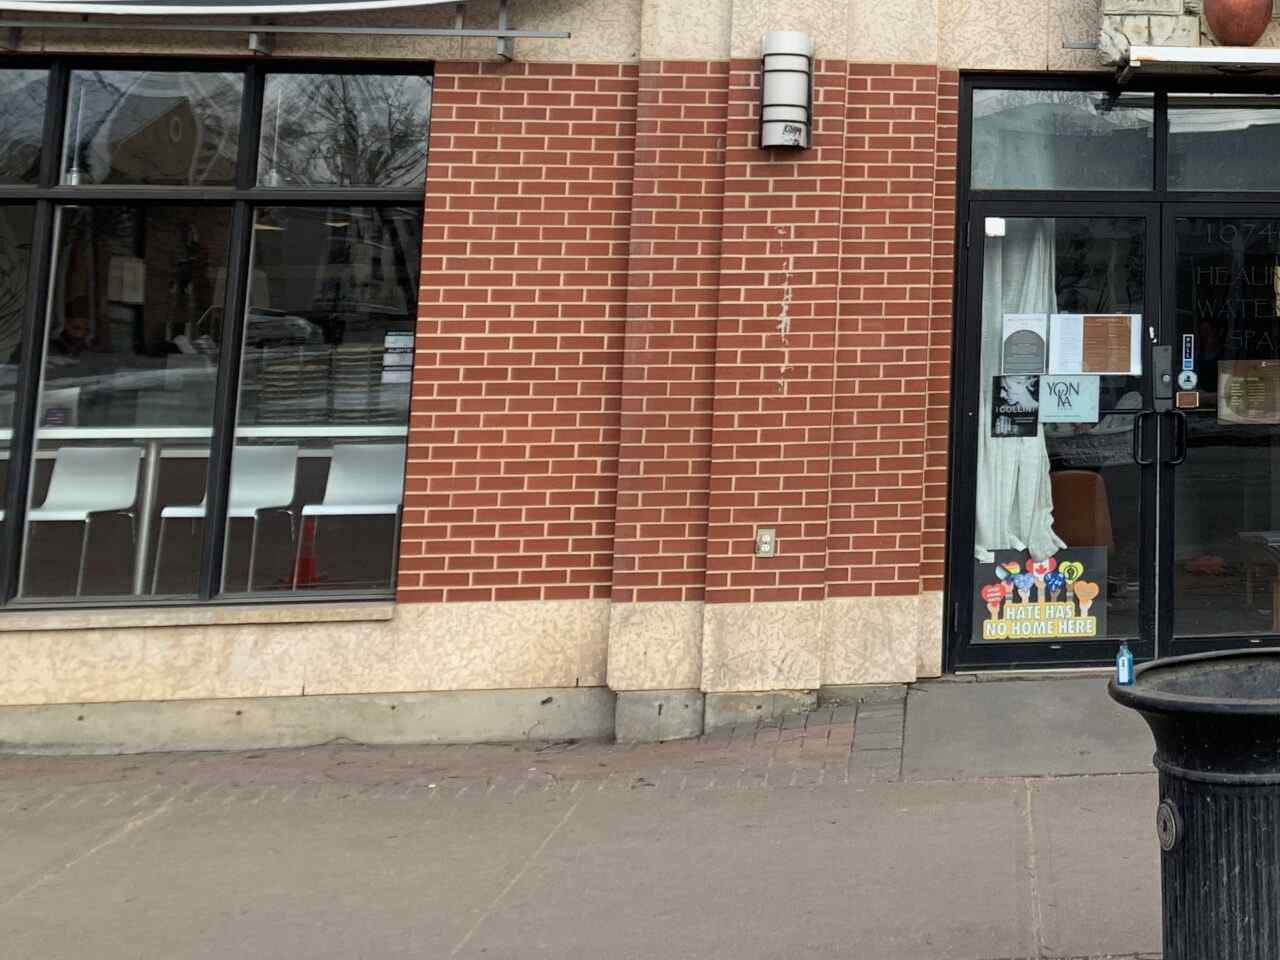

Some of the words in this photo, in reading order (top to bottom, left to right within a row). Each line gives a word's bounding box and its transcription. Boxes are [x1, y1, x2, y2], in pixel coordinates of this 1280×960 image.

[1047, 381, 1081, 397] YON
[1006, 605, 1041, 620] HATE
[1045, 605, 1073, 619] HAS
[986, 621, 1008, 636] NO
[1011, 621, 1057, 635] HOME
[1059, 619, 1093, 634] HERE
